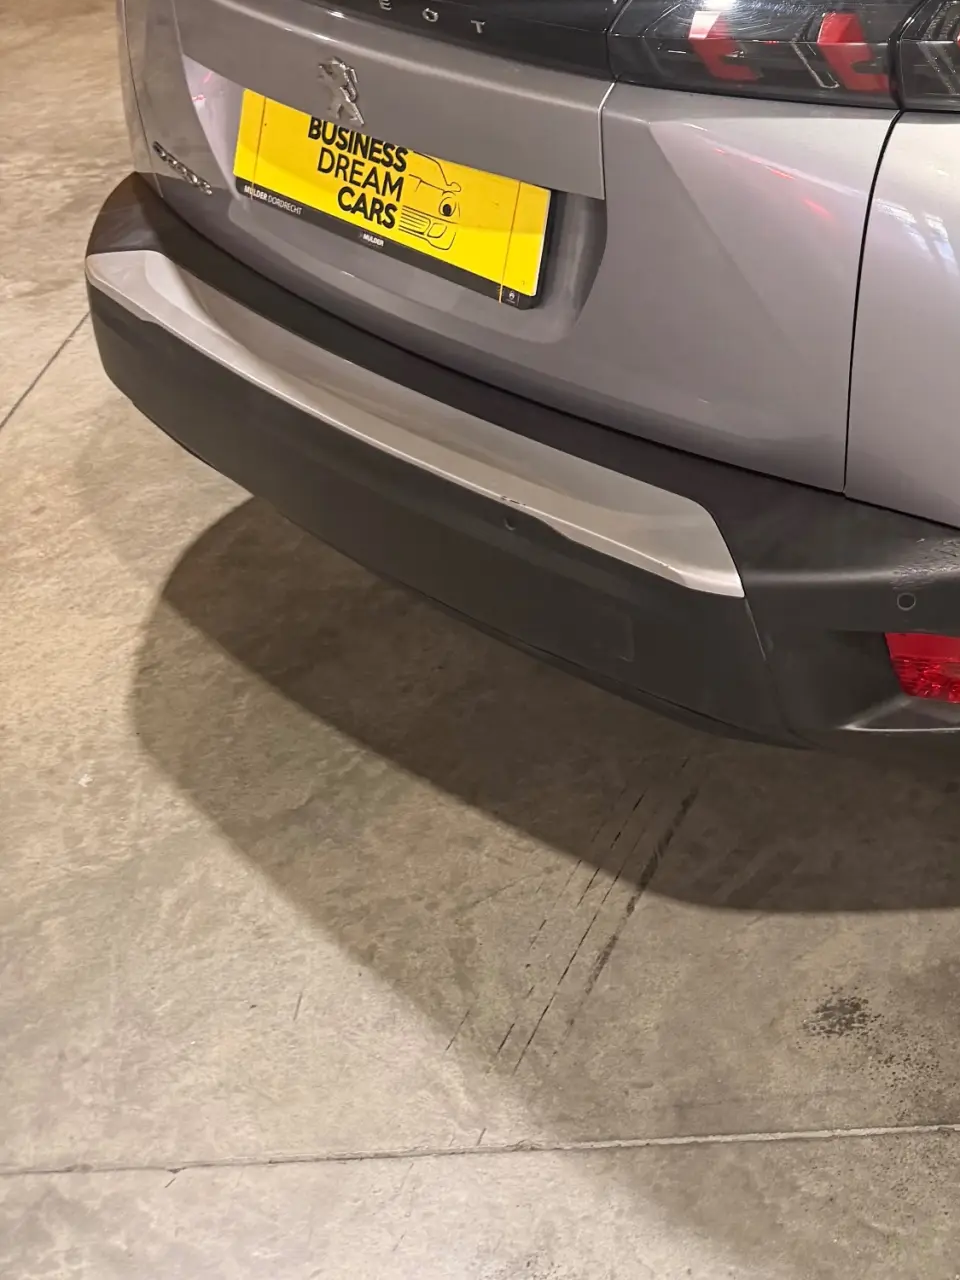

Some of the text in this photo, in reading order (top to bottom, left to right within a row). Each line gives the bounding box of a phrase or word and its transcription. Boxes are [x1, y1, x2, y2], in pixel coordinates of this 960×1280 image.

[308, 116, 409, 173] BUSINESS
[317, 146, 404, 202] DREAM
[243, 184, 303, 215] MULDER DORDRECHT
[337, 186, 398, 229] CARS
